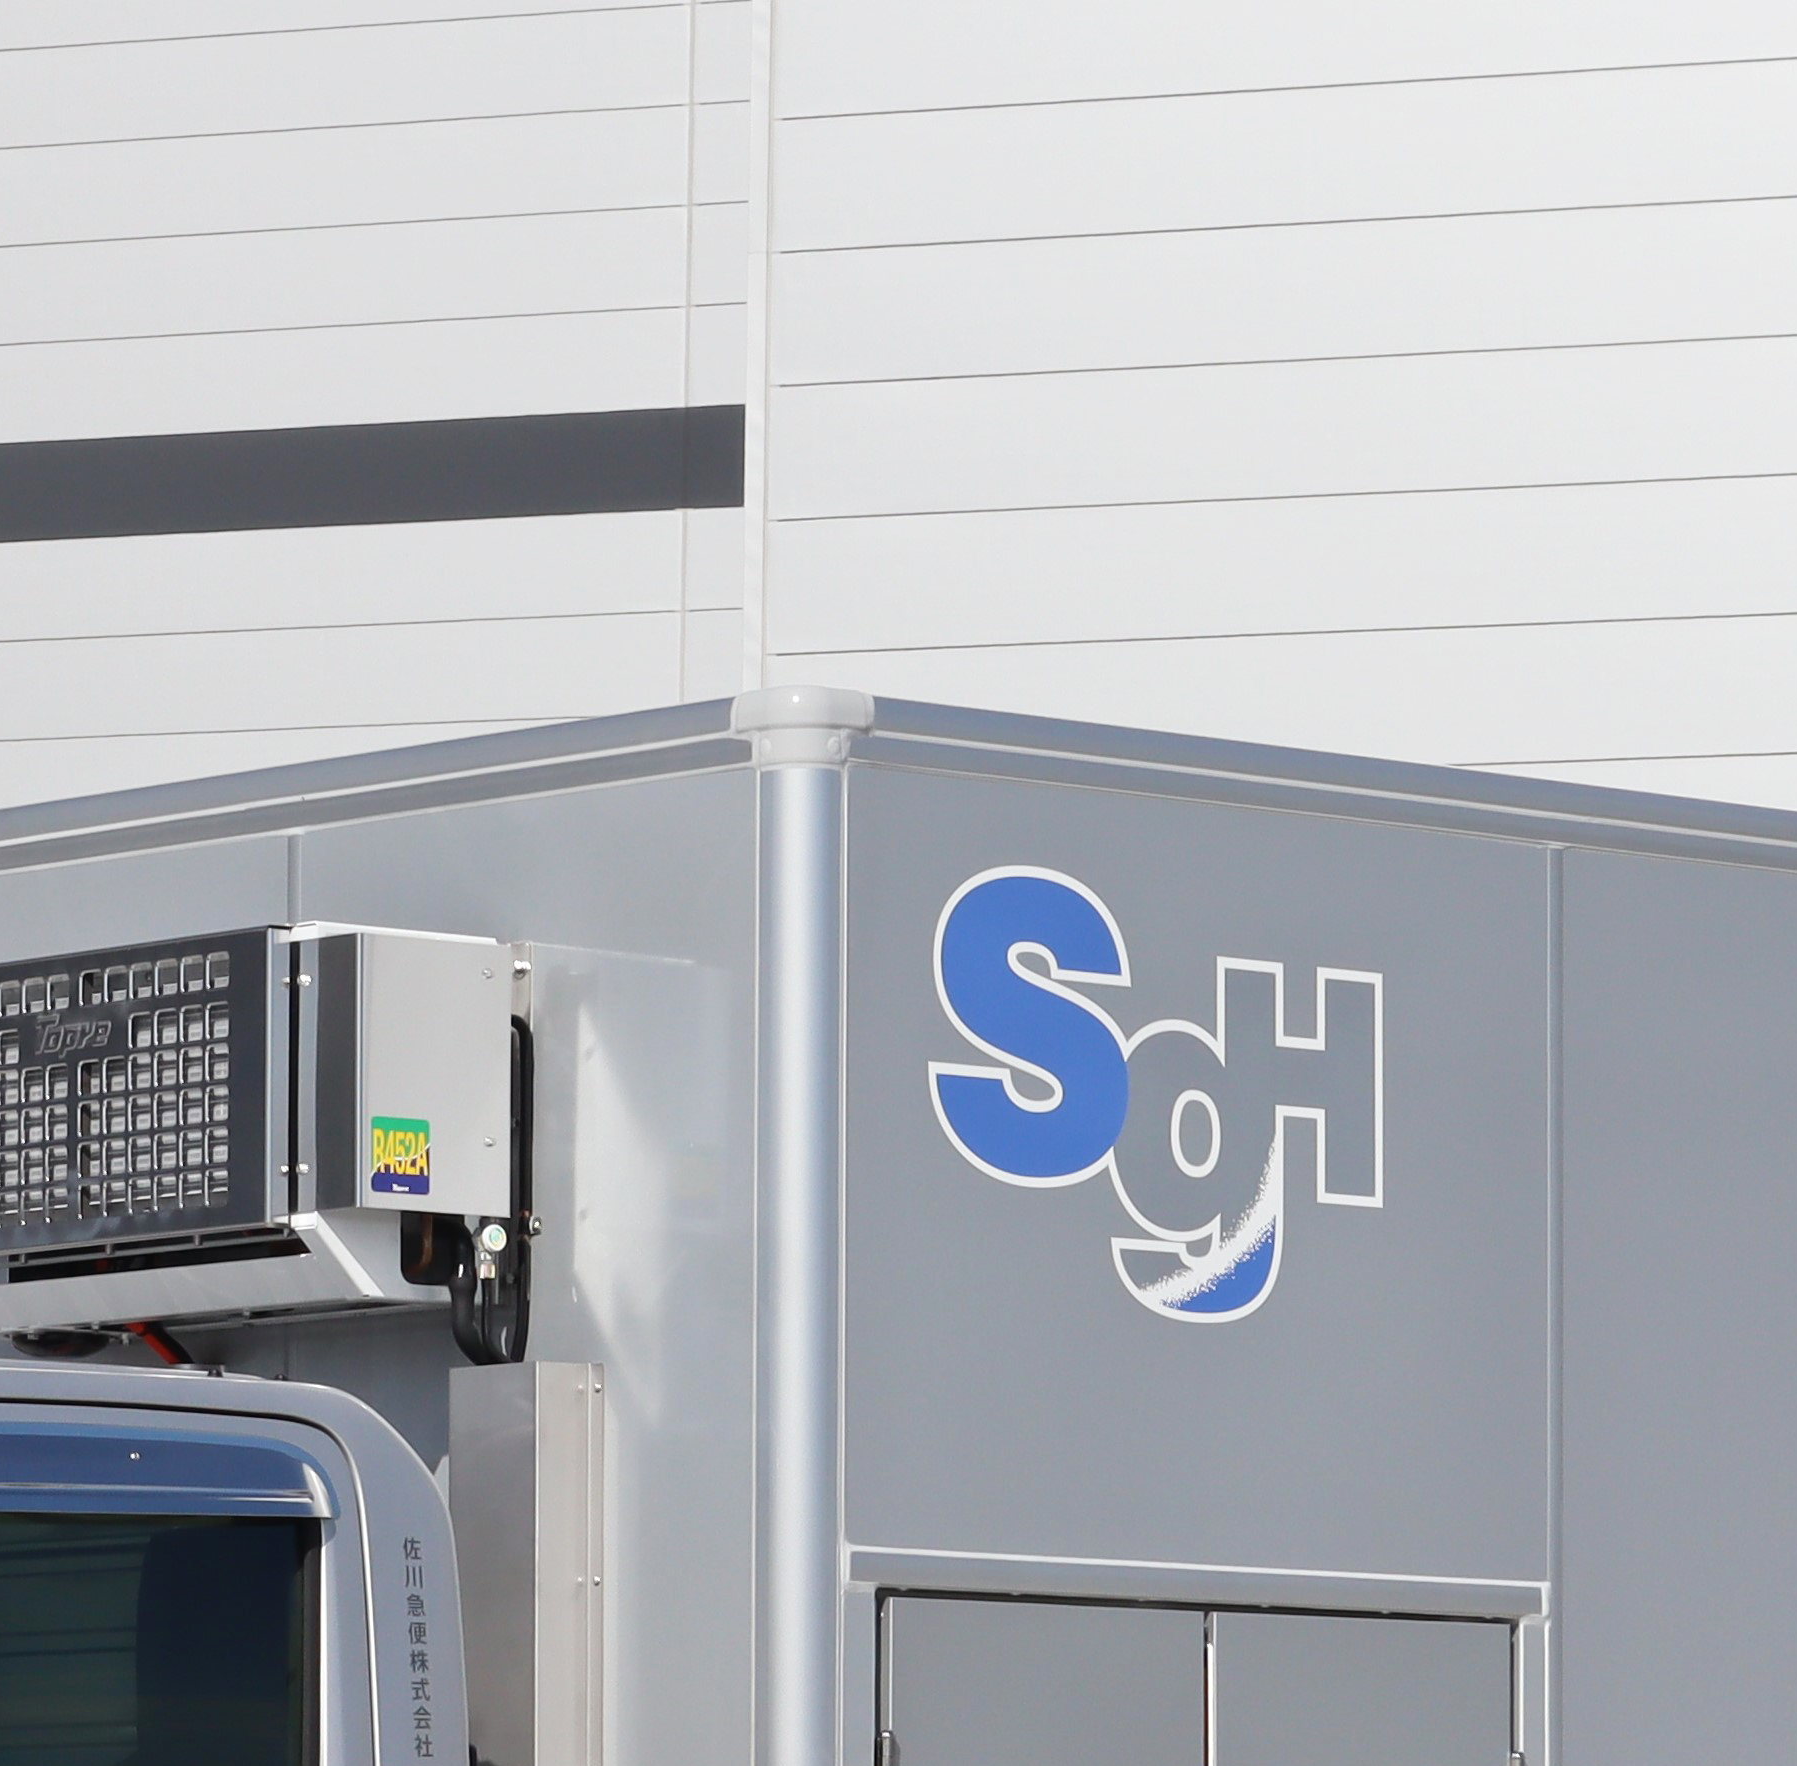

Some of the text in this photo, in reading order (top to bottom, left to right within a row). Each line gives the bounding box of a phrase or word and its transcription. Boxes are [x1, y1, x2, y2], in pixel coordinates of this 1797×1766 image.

[34, 1013, 112, 1059] Topre
[371, 1128, 429, 1176] R452A
[403, 1536, 433, 1758] 佐川急便株式会社
